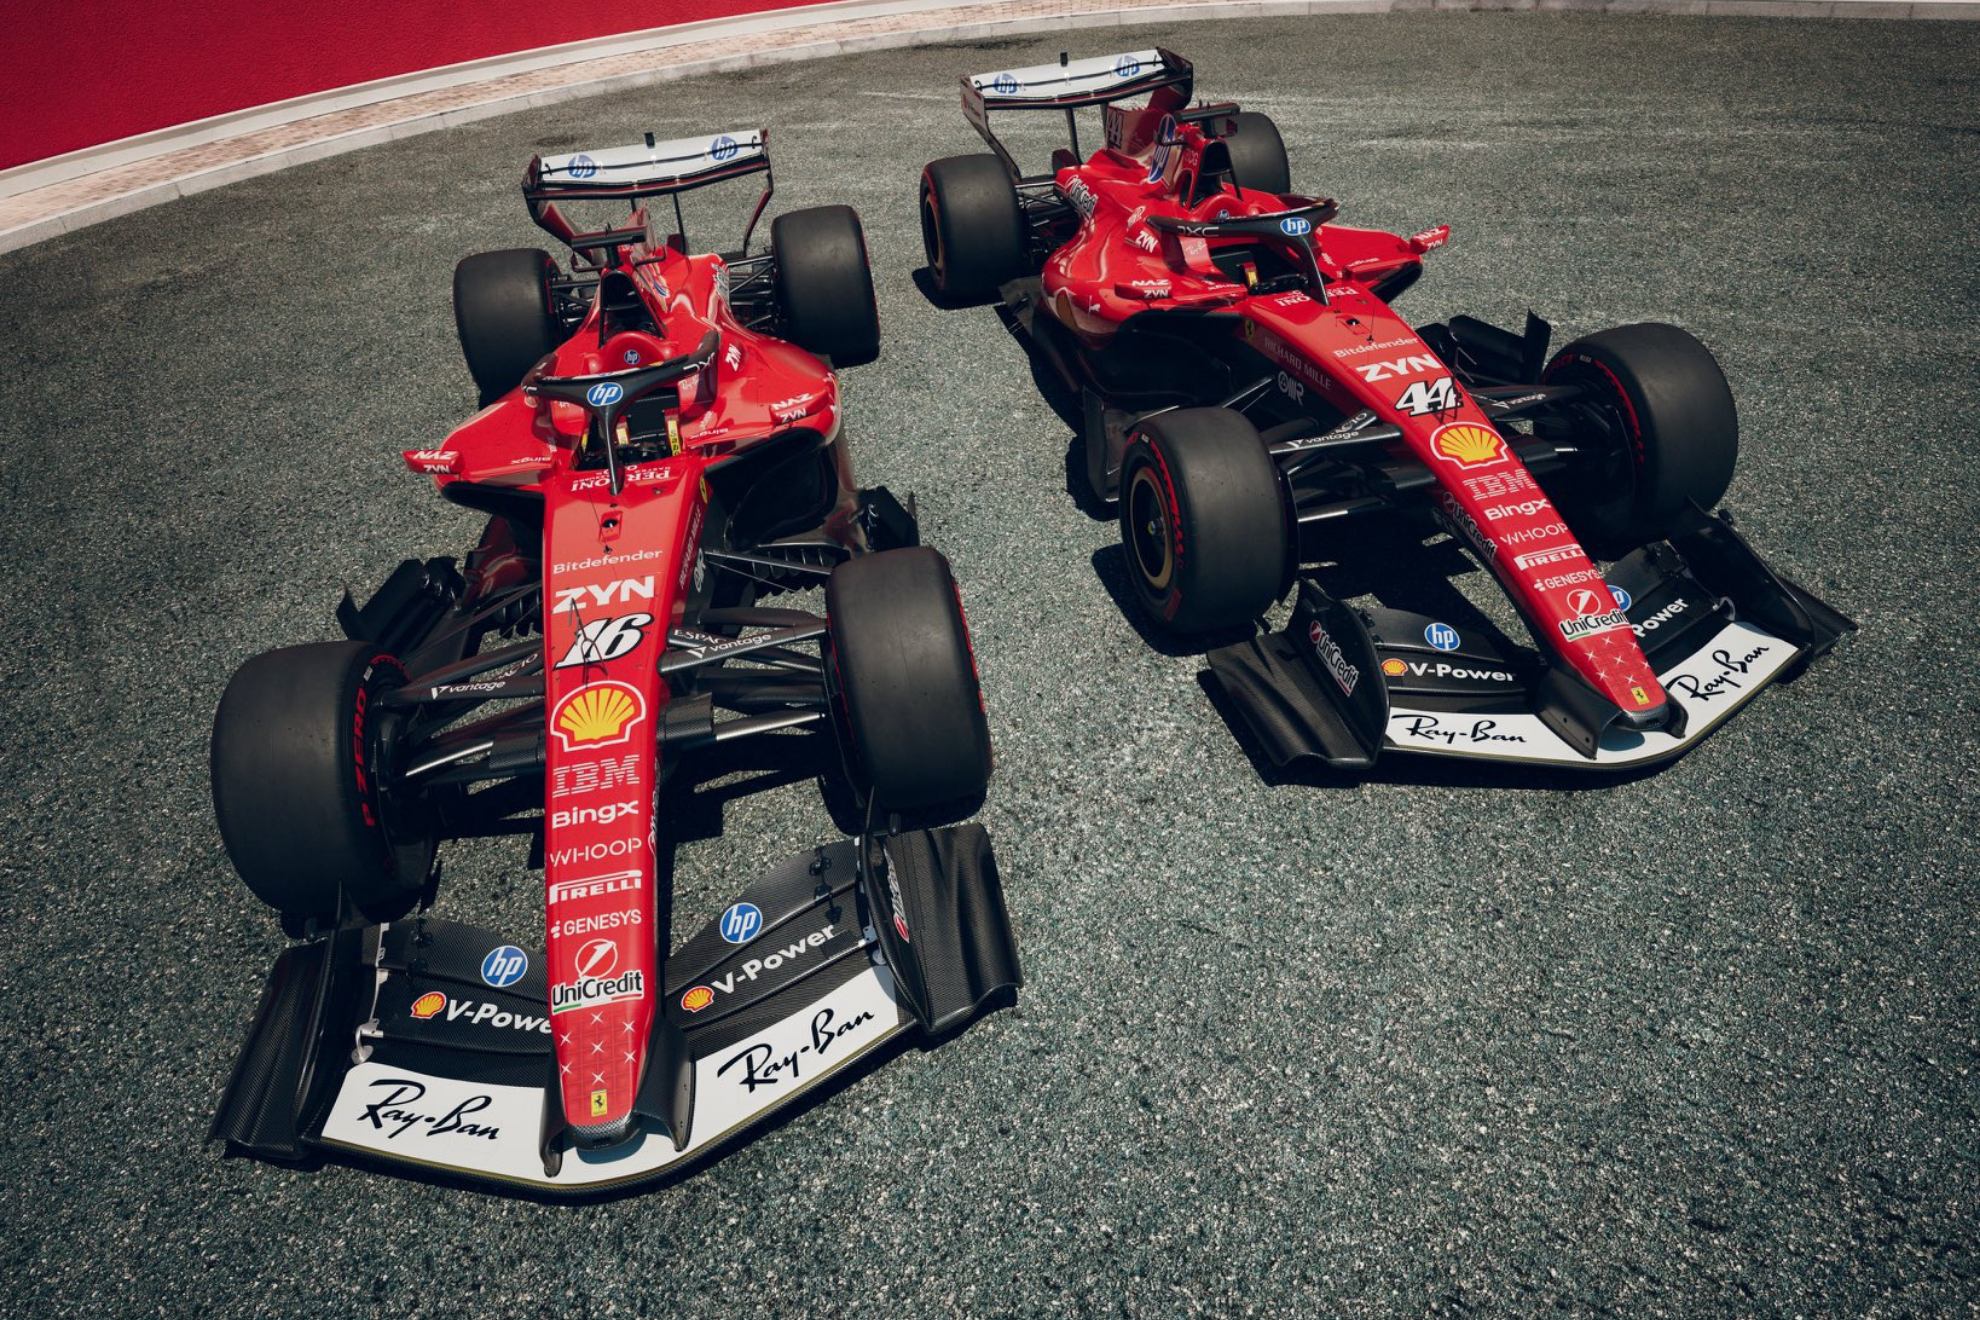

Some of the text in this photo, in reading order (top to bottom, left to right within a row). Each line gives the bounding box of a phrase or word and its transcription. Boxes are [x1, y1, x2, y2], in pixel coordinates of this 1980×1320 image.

[1118, 56, 1139, 76] hp
[996, 74, 1018, 93] hp
[712, 136, 738, 160] hp
[570, 155, 596, 178] hp
[1286, 217, 1307, 235] hp
[1135, 230, 1158, 253] ZYN
[625, 350, 638, 364] hp
[726, 343, 741, 371] ZYN
[1333, 336, 1418, 358] Bitdefender
[1356, 354, 1442, 383] ZYN
[591, 383, 620, 406] hp
[1395, 376, 1465, 417] 44
[780, 408, 807, 423] ZYN
[1306, 431, 1360, 444] vantage
[570, 469, 671, 492] PERONI
[1462, 468, 1538, 501] IBM
[1500, 522, 1568, 546] WHOOP
[553, 550, 663, 575] Bitdefender
[1513, 544, 1586, 572] PIRELLI
[1545, 569, 1602, 590] GENESYS
[552, 575, 655, 614] ZYN
[1560, 609, 1628, 636] UniCredit
[552, 612, 655, 671] 16
[709, 634, 772, 652] vantage
[1431, 623, 1456, 650] hp
[1318, 630, 1359, 690] UniCredit
[1409, 662, 1514, 682] V-Power
[1665, 645, 1770, 702] Ray-Ban
[450, 681, 506, 693] vantage
[353, 687, 369, 794] ZERO
[1391, 714, 1528, 744] Ray-Ban
[552, 754, 640, 798] IBM
[550, 837, 642, 868] WHOOP
[549, 869, 642, 905] PIRELLI
[563, 909, 642, 936] GENESYS
[724, 904, 761, 943] hp
[484, 947, 525, 987] hp
[711, 924, 837, 995] V-Power
[552, 972, 643, 1006] UniCredit
[446, 1000, 553, 1034] V-Powe
[717, 1007, 874, 1094] Ray-Ban
[357, 1079, 500, 1140] Ray-Ban
